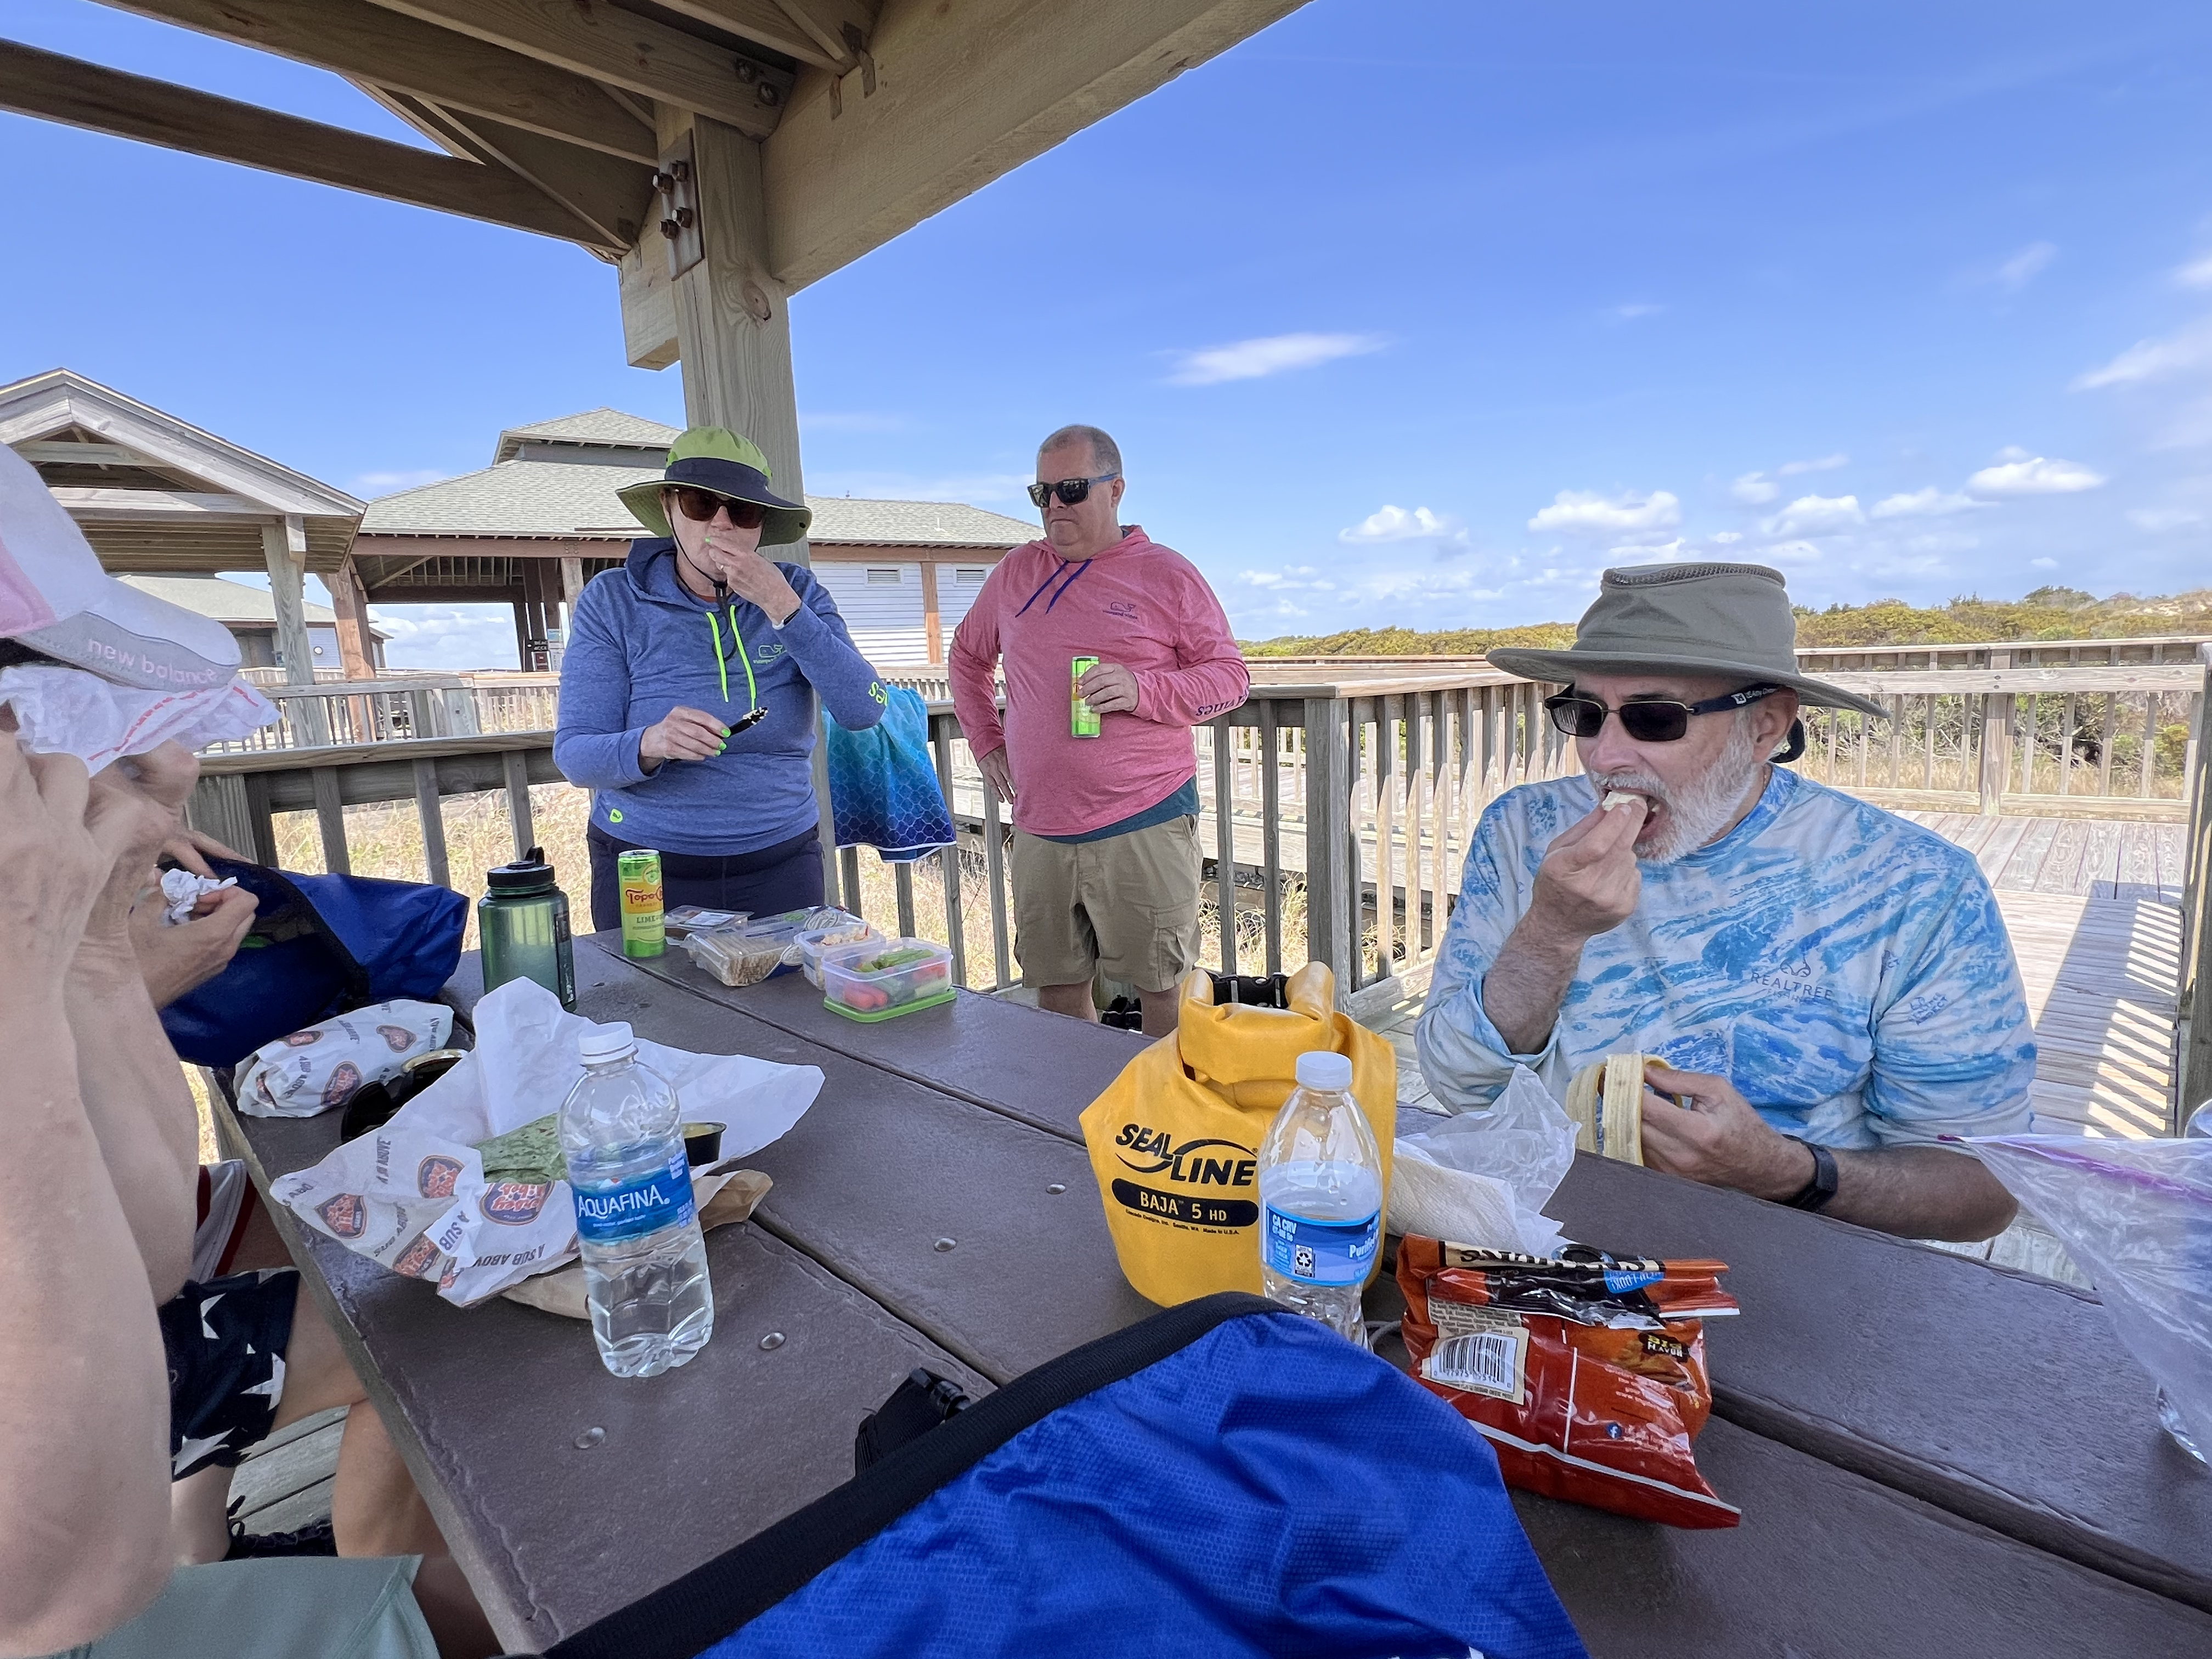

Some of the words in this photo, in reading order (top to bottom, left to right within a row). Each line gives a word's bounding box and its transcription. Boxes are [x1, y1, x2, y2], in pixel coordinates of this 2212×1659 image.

[87, 639, 136, 667] new
[141, 654, 218, 684] balance
[625, 888, 655, 904] Topo
[636, 915, 656, 924] LIME
[1750, 972, 1836, 1001] REALTREE
[1115, 1124, 1174, 1161] SEAL
[1170, 1155, 1257, 1186] LINE
[578, 1184, 665, 1220] AQUAFINA
[1139, 1190, 1180, 1216] BAJA
[1191, 1203, 1203, 1219] 5
[1209, 1209, 1227, 1222] HD
[458, 1210, 470, 1223] A
[1272, 1214, 1282, 1228] CA
[1282, 1218, 1297, 1234] CRV
[439, 1222, 463, 1251] SUB
[511, 1249, 537, 1266] SUB
[537, 1243, 545, 1259] A
[473, 1253, 511, 1268] ABOV
[1647, 1334, 1683, 1351] BIG
[1647, 1341, 1683, 1358] FLAVOR
